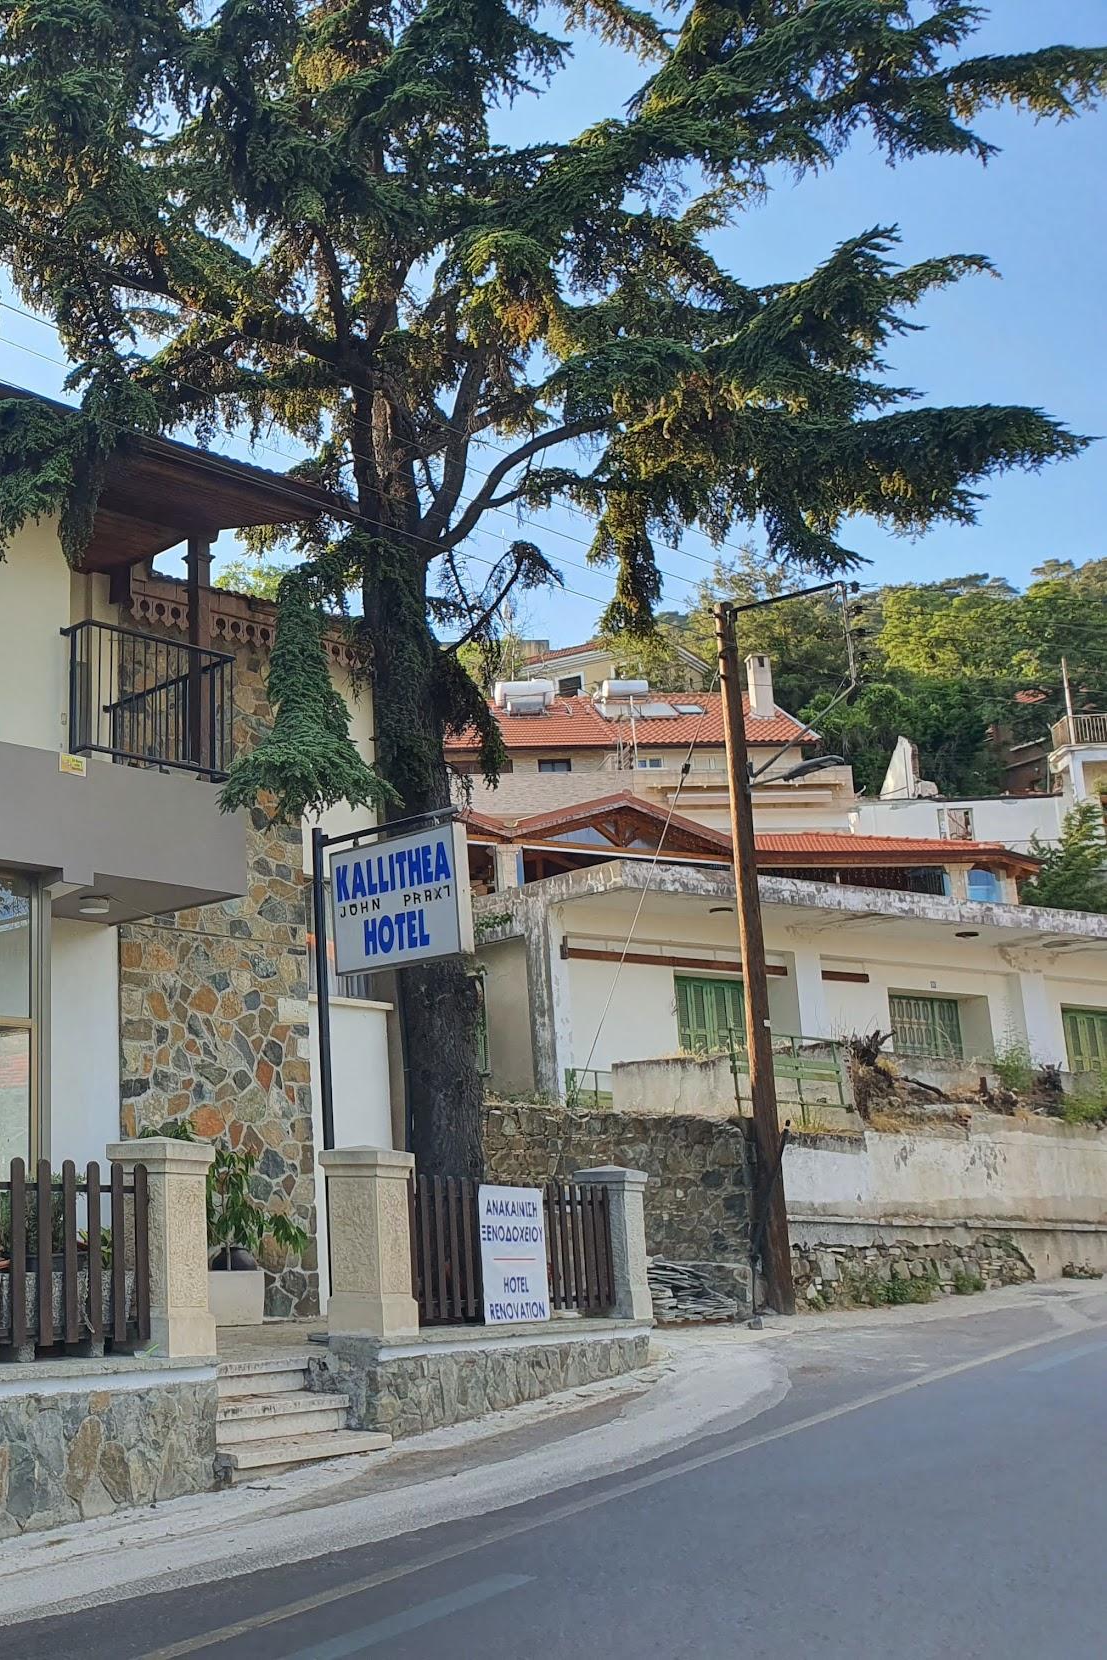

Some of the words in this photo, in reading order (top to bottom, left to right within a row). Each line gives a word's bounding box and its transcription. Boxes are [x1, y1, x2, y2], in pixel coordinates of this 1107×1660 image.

[335, 841, 452, 903] KALLITHEA
[340, 897, 381, 918] JOHN
[363, 908, 431, 957] HOTEL
[481, 1224, 543, 1242] ΞΕΝΟΔΟΧΕΙΟΥ
[503, 1276, 530, 1293] HOTEL
[489, 1301, 546, 1320] RENOVATION
